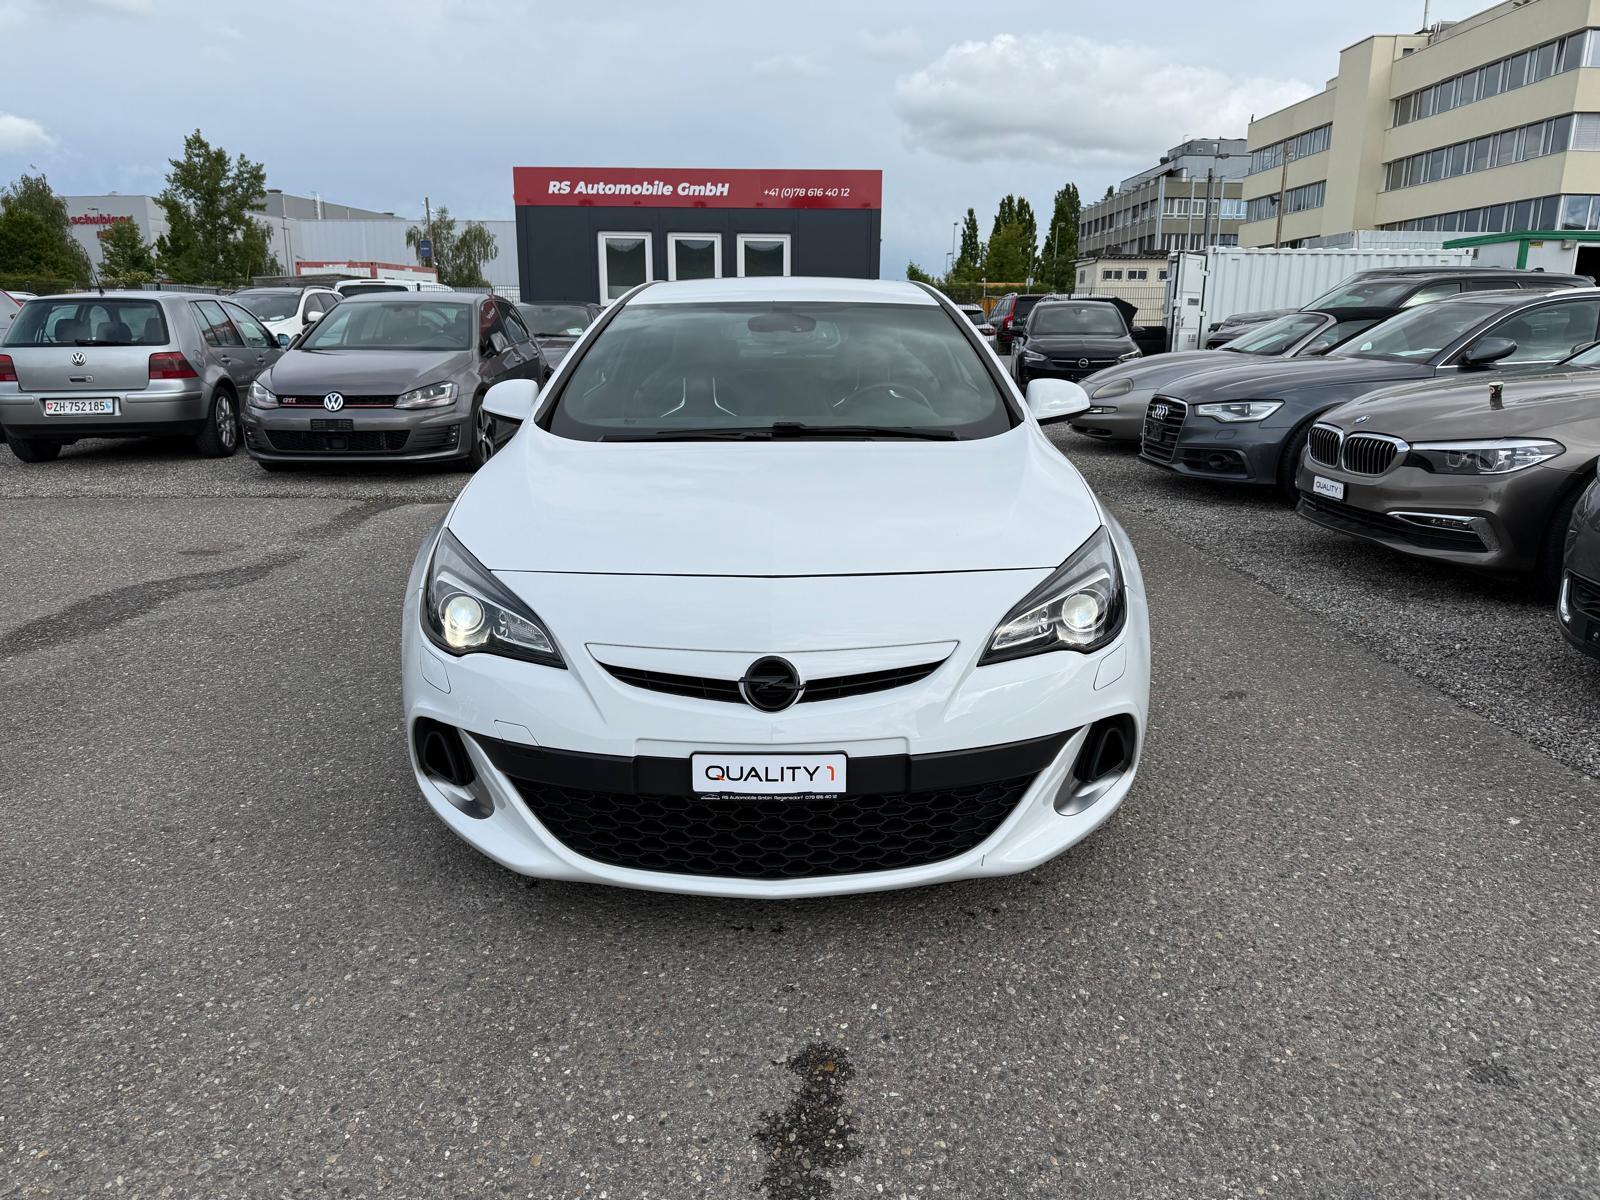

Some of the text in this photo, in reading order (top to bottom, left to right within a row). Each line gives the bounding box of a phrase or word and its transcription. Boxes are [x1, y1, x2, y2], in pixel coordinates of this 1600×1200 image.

[548, 181, 730, 197] RS Automobile GmbH
[763, 187, 851, 199] +41 (0)78 616 40 12
[1316, 481, 1339, 494] QUALITY
[705, 764, 835, 782] QUALITY 1
